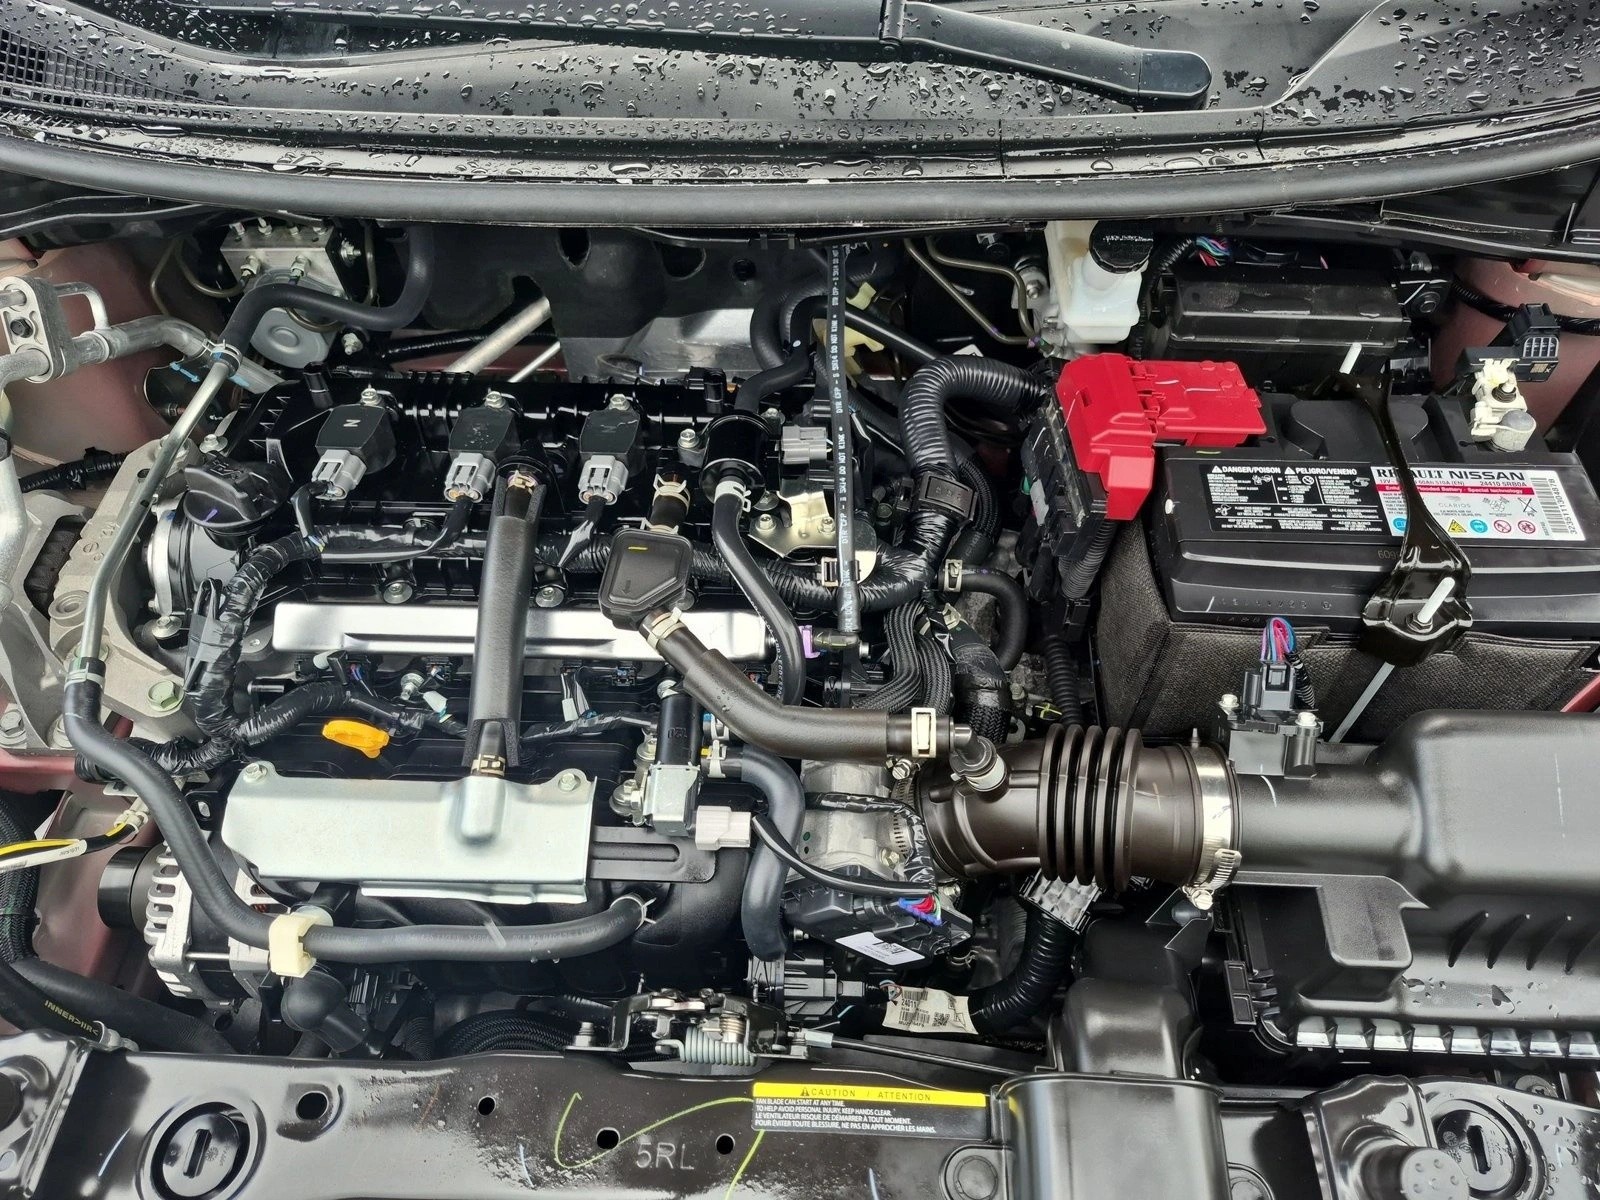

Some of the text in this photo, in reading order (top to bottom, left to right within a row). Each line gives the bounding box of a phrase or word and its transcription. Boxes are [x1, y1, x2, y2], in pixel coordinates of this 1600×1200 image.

[830, 346, 838, 354] DO
[838, 466, 846, 474] DO
[1296, 468, 1358, 476] PELIGRO/VENENO
[1448, 470, 1525, 480] NISSAN
[811, 1088, 856, 1097] CAUTION
[878, 1092, 931, 1101] ATTENTION
[636, 1142, 695, 1170] 5RL
